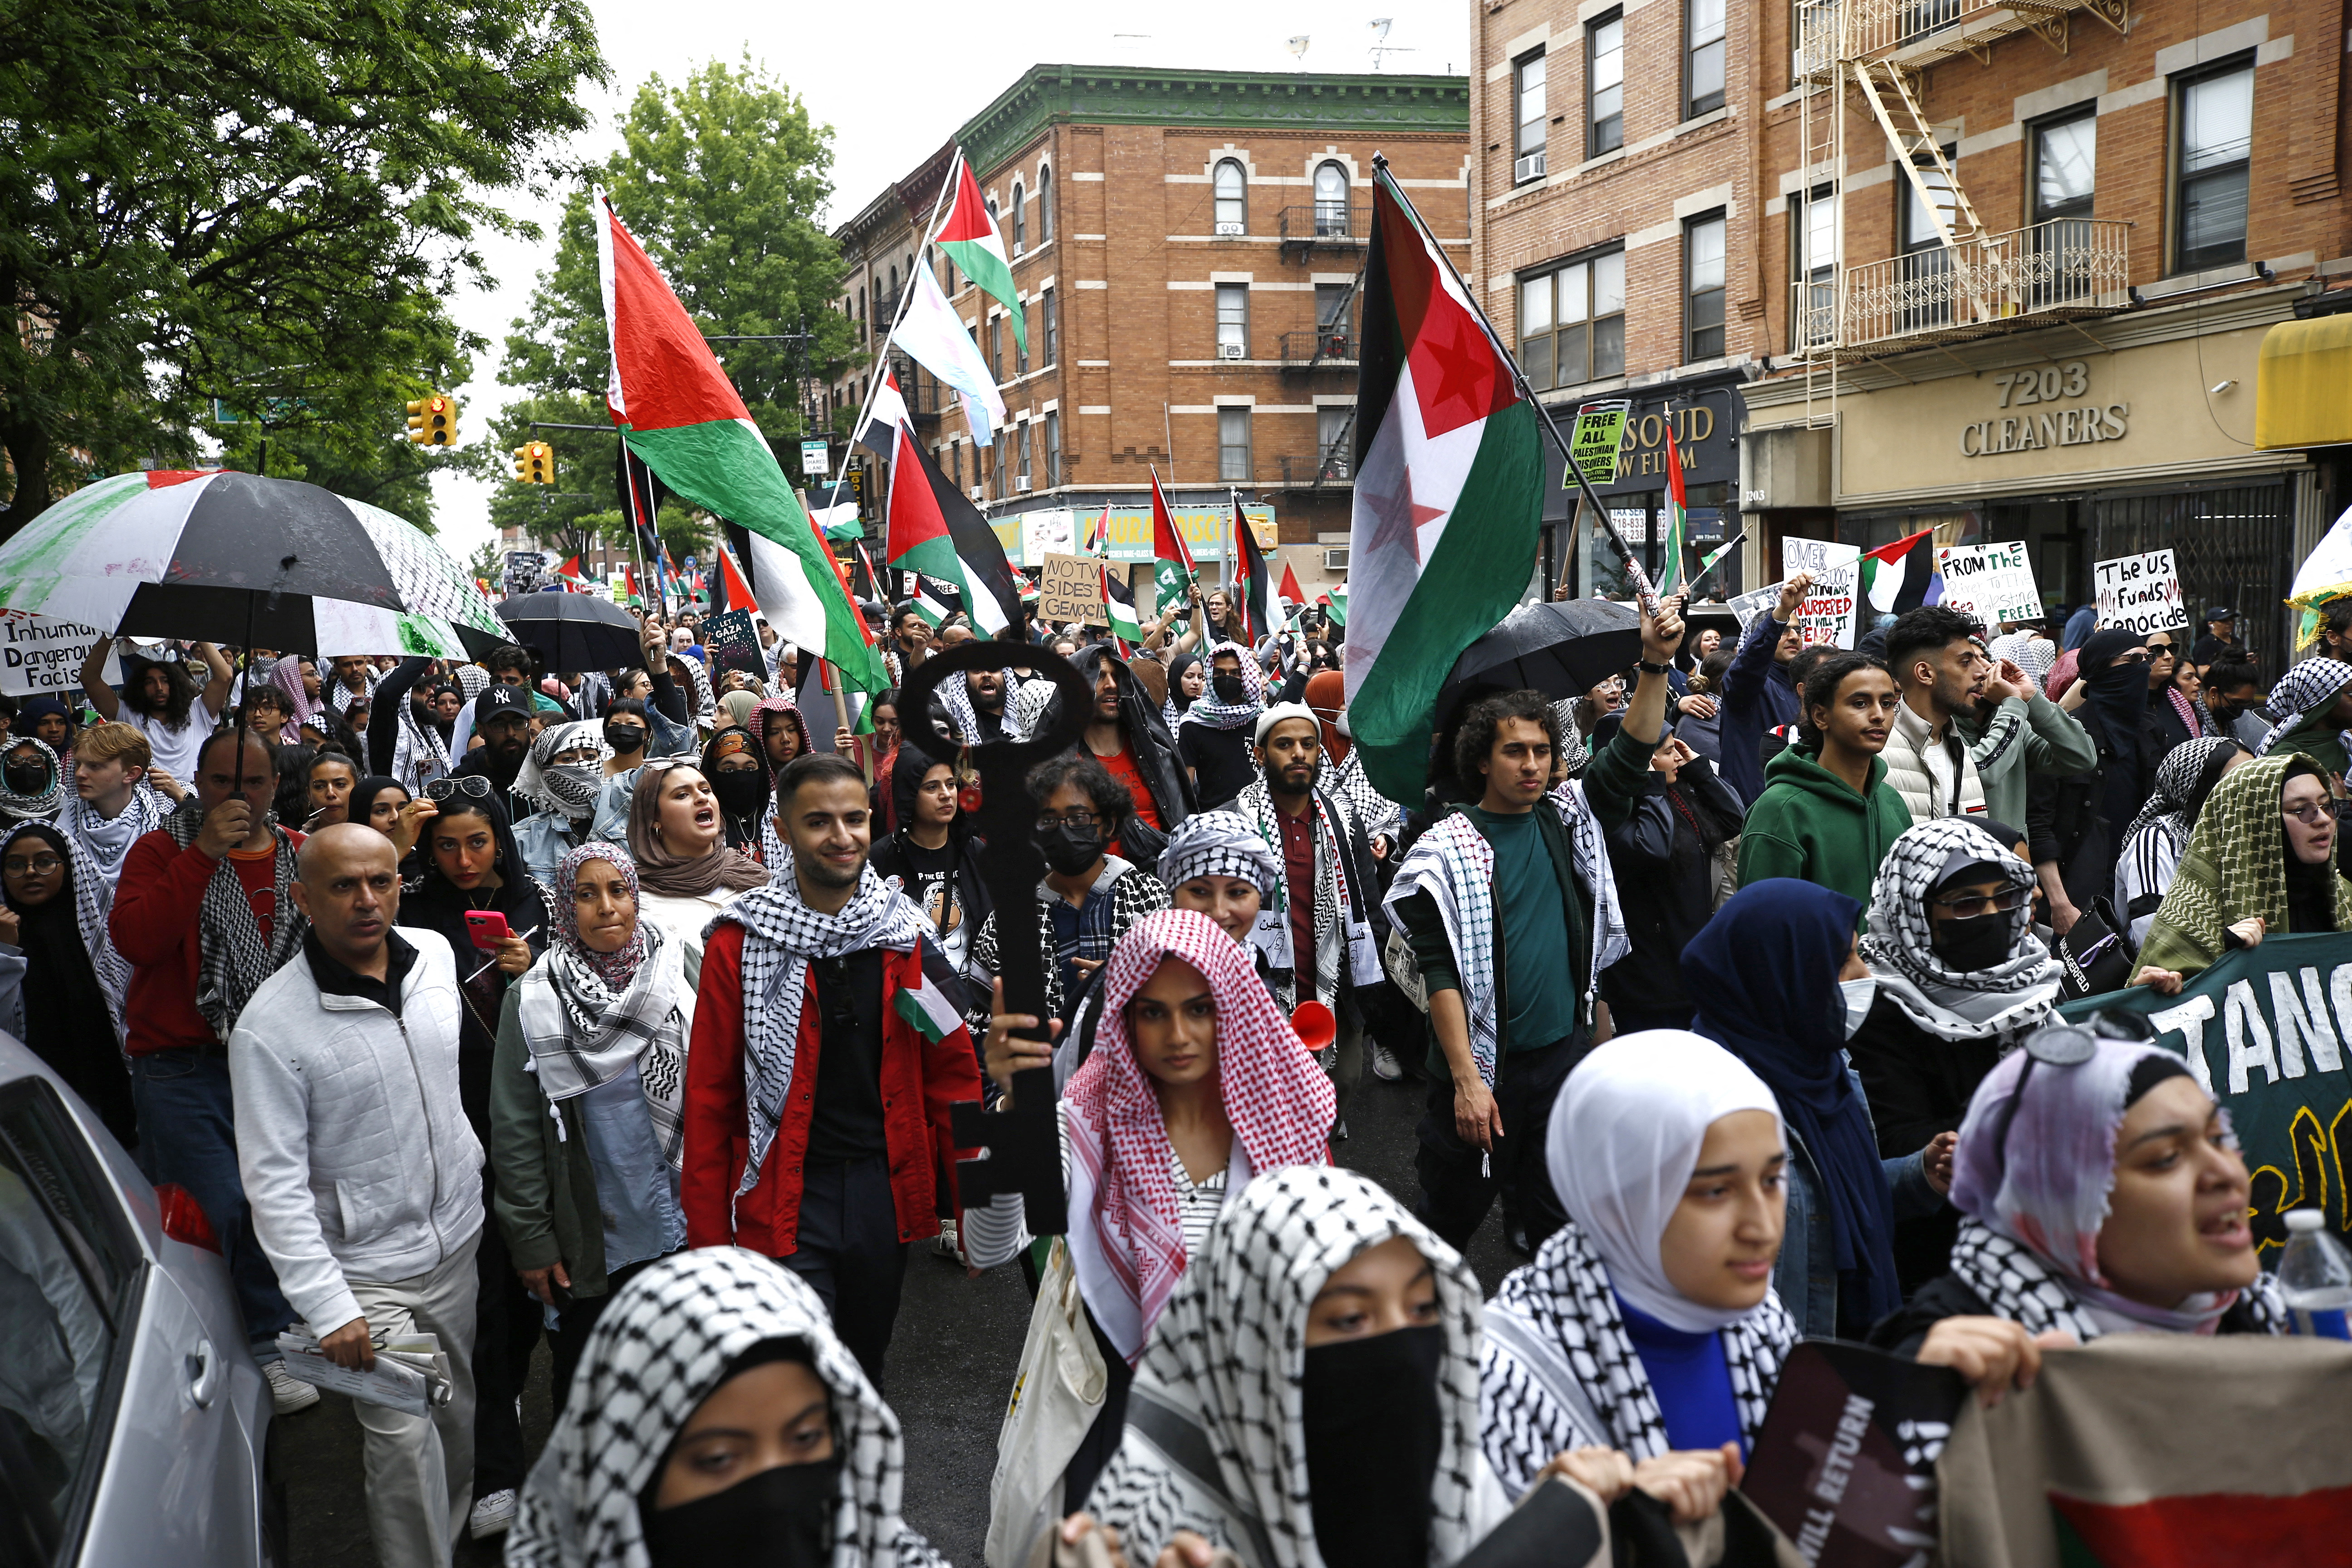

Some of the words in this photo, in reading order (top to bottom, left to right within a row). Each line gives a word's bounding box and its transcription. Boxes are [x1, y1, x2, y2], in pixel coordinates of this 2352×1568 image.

[1994, 362, 2087, 407] 7203
[1583, 413, 1617, 429] FREE
[1959, 402, 2129, 456] CLEANERS
[1581, 430, 1606, 444] ALL
[1573, 445, 1615, 458] PALESTINIAN
[1641, 446, 1698, 475] FIM
[1746, 490, 1765, 502] 7203
[1784, 539, 1827, 570] OVER
[1942, 557, 1985, 579] FROM
[1988, 552, 2022, 569] The
[1048, 559, 1073, 578] NO
[2098, 562, 2141, 584] The
[1947, 581, 1982, 597] River
[1987, 576, 2000, 588] To
[2002, 573, 2032, 587] The
[1951, 600, 1974, 612] Sea
[1976, 590, 2038, 612] Palestine
[715, 623, 742, 638] GAZA
[720, 618, 732, 627] LET
[1815, 617, 1833, 628] WILL
[1836, 616, 1848, 631] IT
[723, 633, 739, 643] LIVE
[4, 644, 96, 670] Dangerou
[494, 688, 511, 704] NY
[2063, 950, 2090, 992] LAGERFELD
[1815, 1393, 1876, 1504] RETURN
